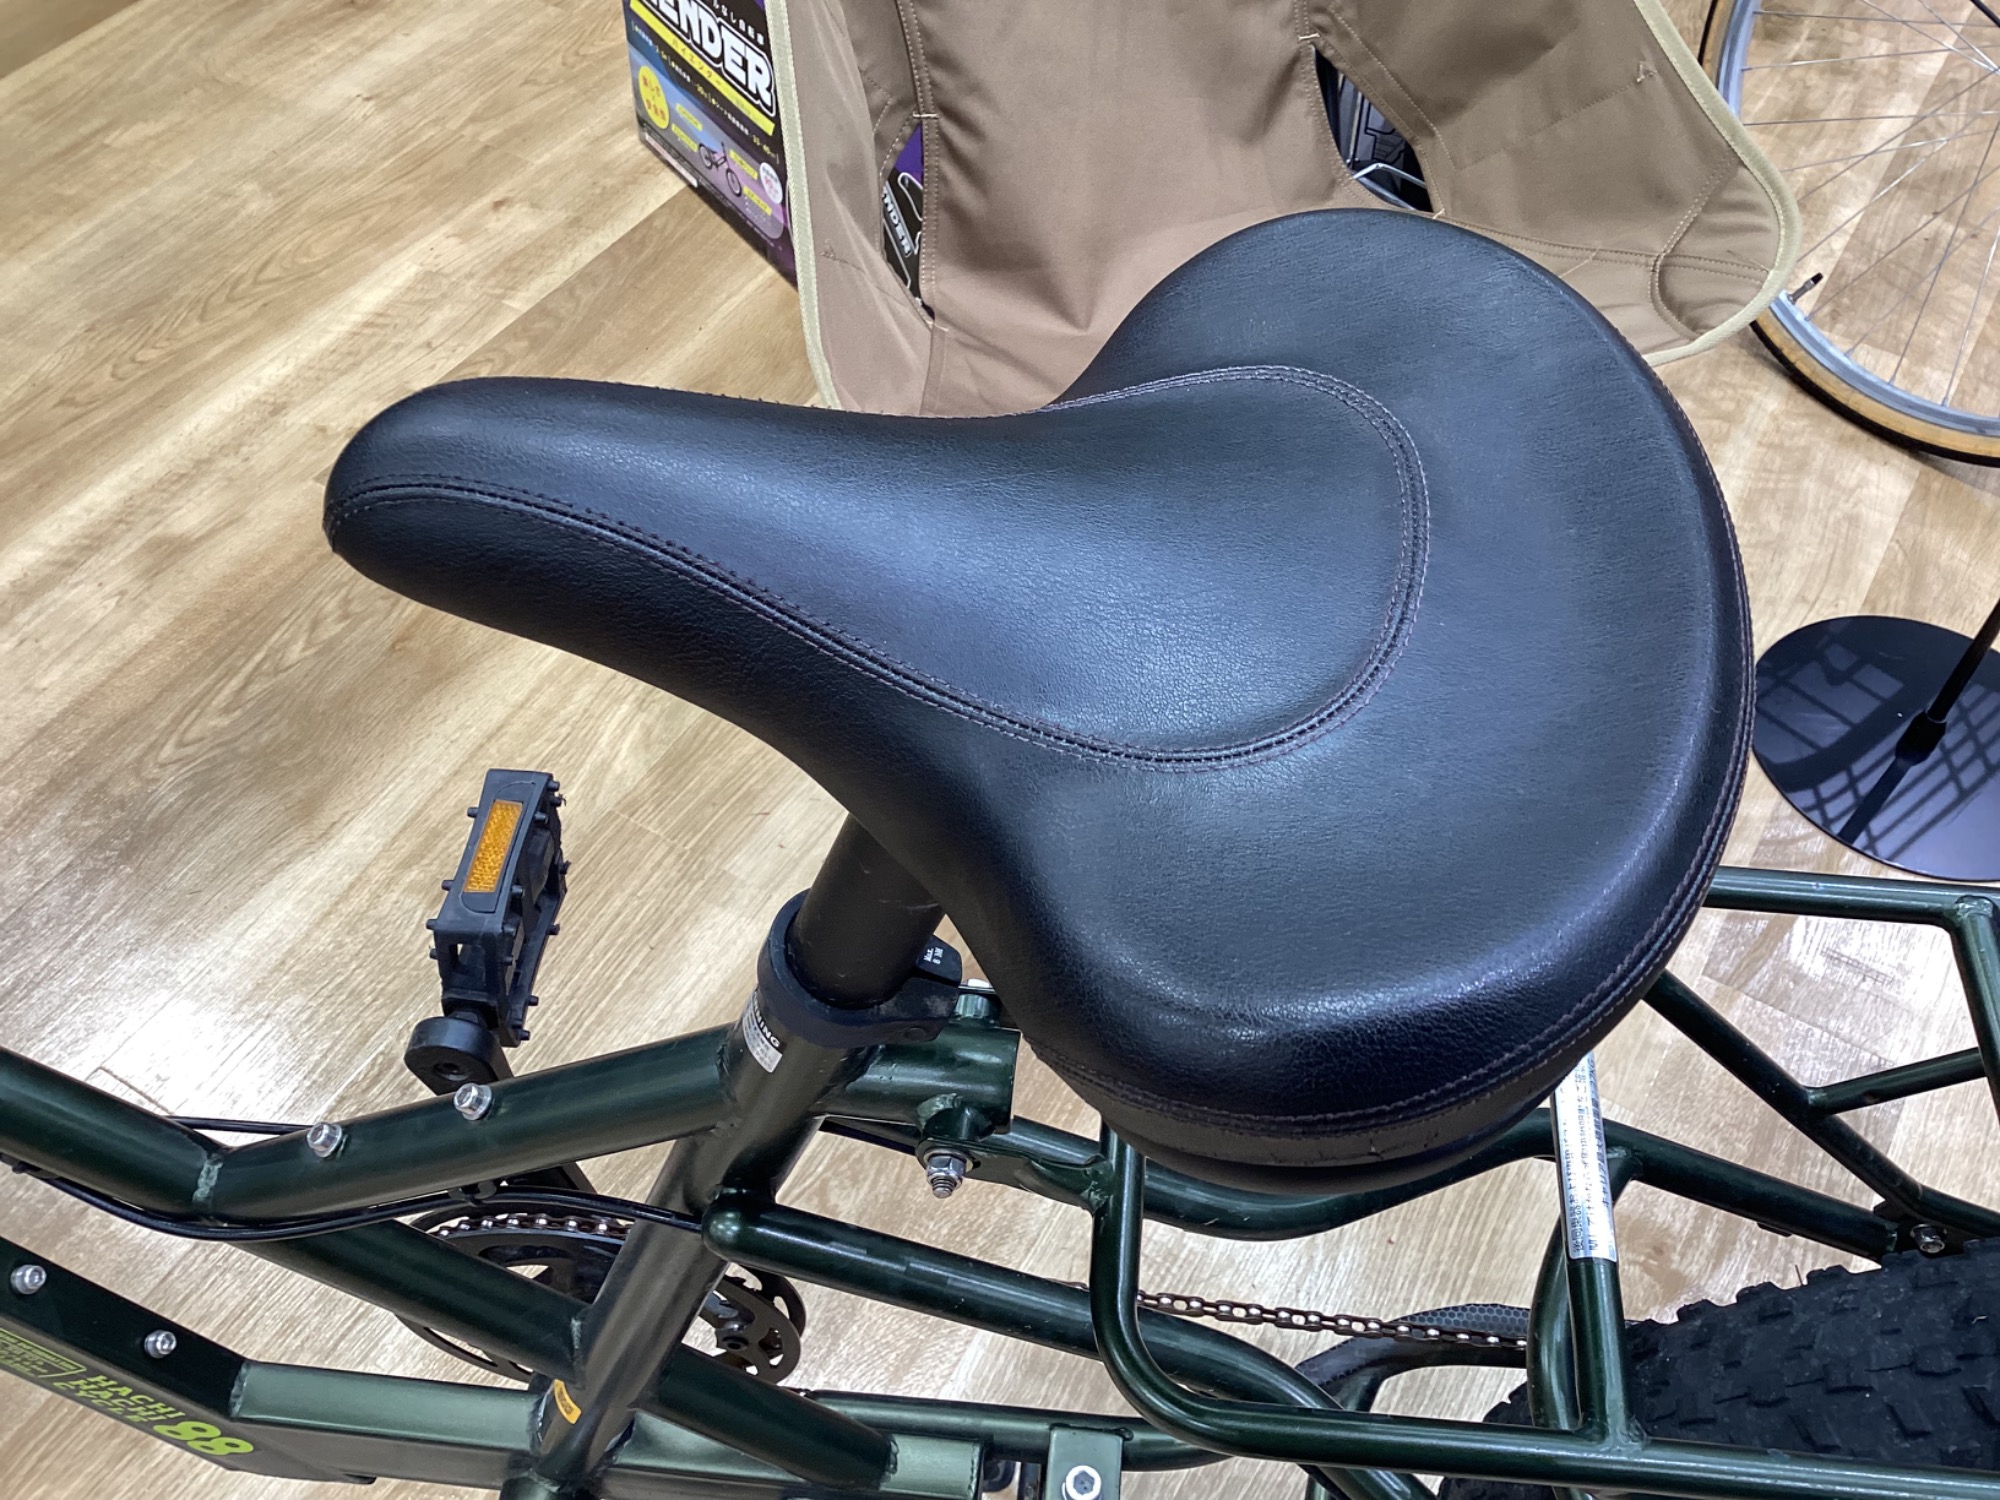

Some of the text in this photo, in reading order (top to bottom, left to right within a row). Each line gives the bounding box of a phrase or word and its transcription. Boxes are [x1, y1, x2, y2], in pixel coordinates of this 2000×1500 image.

[67, 1379, 167, 1421] HACHI
[86, 1375, 185, 1419] HACHI
[153, 1420, 254, 1456] 88
